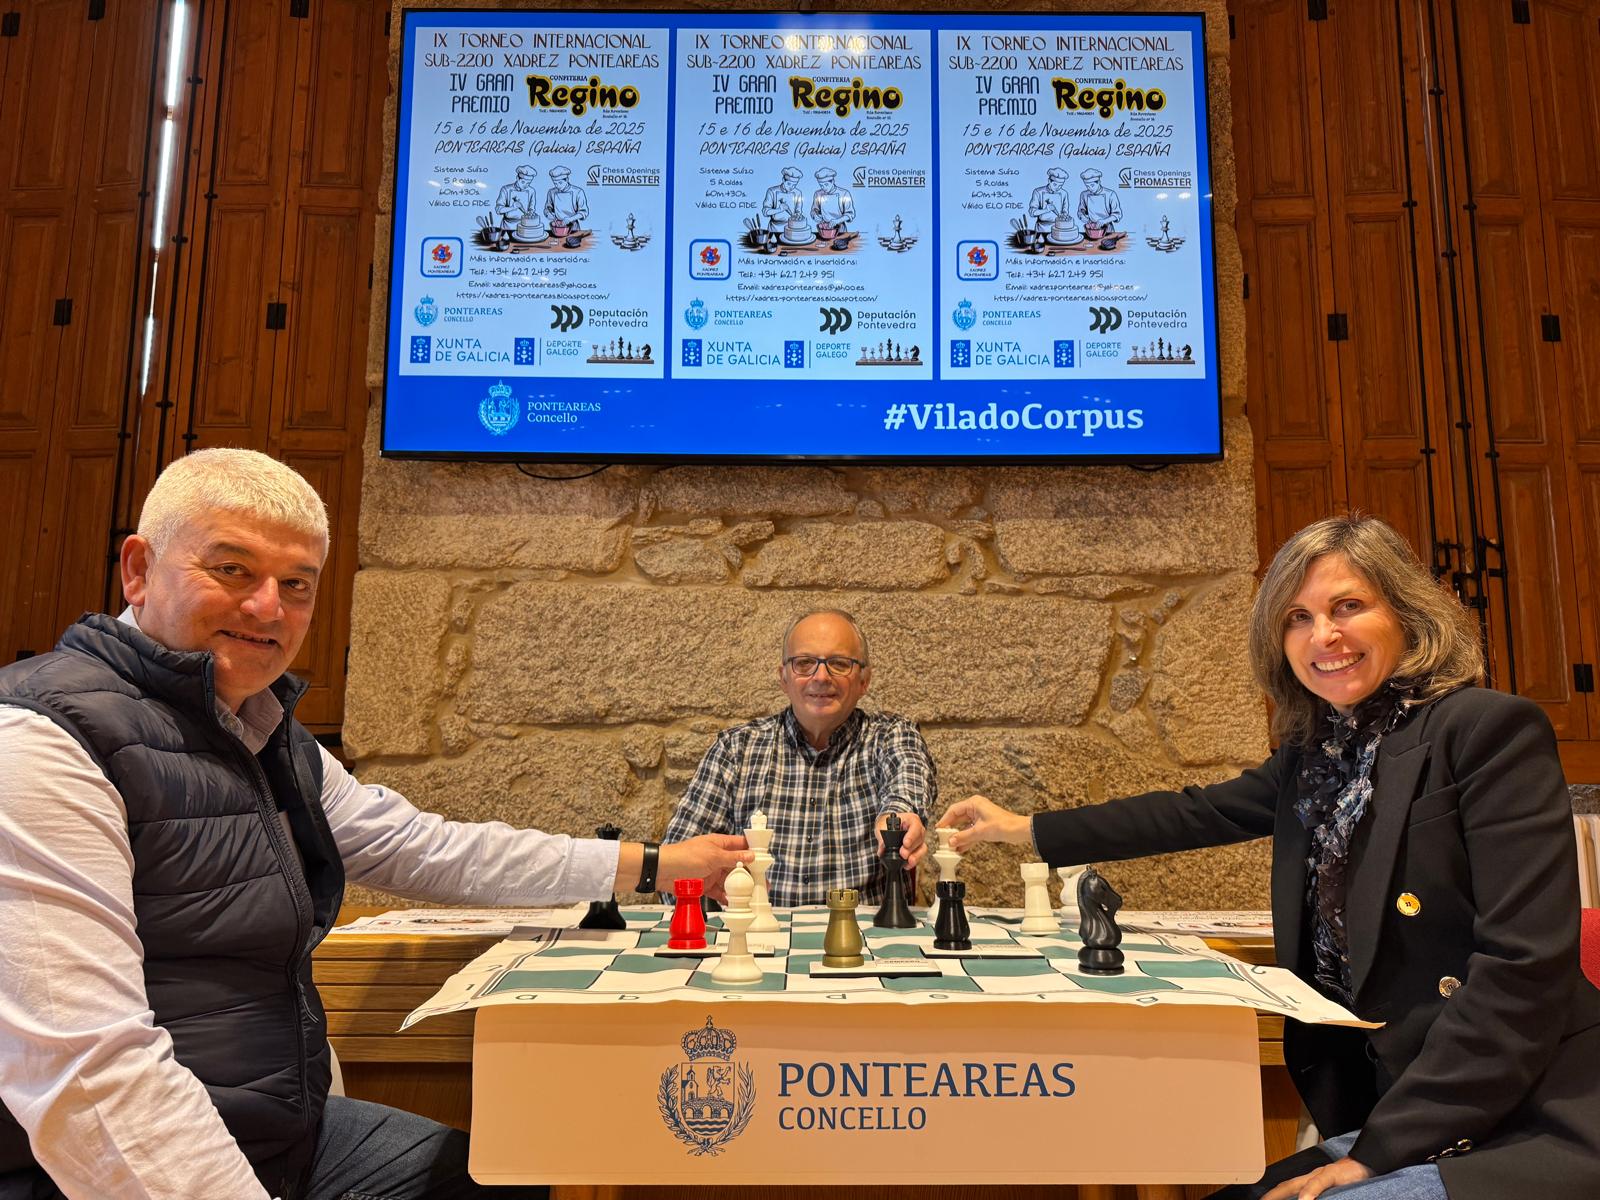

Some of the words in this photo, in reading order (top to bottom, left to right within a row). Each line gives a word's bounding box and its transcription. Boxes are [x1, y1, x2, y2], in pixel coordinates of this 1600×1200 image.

[433, 33, 448, 48] IX
[460, 34, 523, 48] TORNEO
[533, 34, 651, 49] INTERNACIONAL
[695, 34, 709, 49] IX
[721, 34, 785, 49] TORNEO
[957, 36, 971, 50] IX
[982, 36, 1046, 50] TORNEO
[1056, 37, 1174, 51] INTERNACIONAL
[425, 53, 493, 67] SUB-2200
[503, 54, 559, 68] XADREZ
[569, 55, 659, 68] PONTEAREAS
[687, 55, 755, 69] SUB-2200
[766, 55, 821, 69] XADREZ
[832, 56, 921, 69] PONTEAREAS
[949, 56, 1018, 70] SUB-2200
[1028, 56, 1083, 70] XADREZ
[1094, 57, 1184, 71] PONTEAREAS
[450, 74, 467, 91] IV
[477, 74, 514, 91] GRAN
[713, 75, 730, 92] IV
[739, 75, 776, 92] GRAN
[976, 76, 992, 94] IV
[1002, 76, 1039, 94] GRAN
[526, 75, 640, 116] Regino
[789, 76, 903, 118] Regino
[1052, 77, 1166, 119] Regino
[452, 95, 509, 113] PREMIO
[716, 97, 773, 114] PREMIO
[979, 98, 1036, 115] PREMIO
[434, 121, 453, 134] 15
[456, 125, 463, 134] e
[469, 122, 486, 134] 16
[491, 120, 508, 134] de
[509, 120, 581, 135] Novembro
[586, 121, 602, 134] de
[605, 122, 645, 135] 2025
[699, 123, 715, 136] 15
[720, 127, 727, 136] e
[734, 123, 750, 136] 16
[755, 121, 772, 136] de
[775, 121, 846, 136] Novembro
[850, 121, 867, 136] de
[870, 124, 909, 136] 2025
[963, 124, 980, 137] 15
[984, 129, 992, 137] e
[998, 124, 1015, 137] 16
[1020, 122, 1037, 137] de
[1039, 122, 1110, 138] Novembro
[1114, 123, 1131, 137] de
[1134, 125, 1173, 138] 2025
[435, 141, 525, 154] PONTEAREAS
[529, 140, 582, 156] (Galicia)
[586, 139, 641, 154] ESPAÑA
[700, 142, 789, 155] PONTEAREAS
[793, 142, 846, 158] (Galicia)
[851, 141, 906, 155] ESPAÑA
[965, 143, 1054, 156] PONTEAREAS
[1058, 143, 1111, 159] (Galicia)
[1116, 142, 1171, 157] ESPAÑA
[626, 167, 660, 176] Openings
[891, 169, 925, 177] Openings
[1158, 170, 1191, 178] Openings
[602, 175, 659, 184] PROMASTER
[868, 177, 925, 185] PROMASTER
[1134, 178, 1191, 186] PROMASTER
[490, 268, 508, 276] +34
[512, 268, 529, 276] 627
[531, 268, 550, 276] 249
[553, 268, 567, 276] 951
[780, 270, 797, 278] 627
[799, 270, 818, 278] 249
[445, 307, 502, 316] PONTEAREAS
[589, 309, 648, 318] Deputación
[715, 310, 772, 318] PONTEAREAS
[858, 310, 916, 320] Deputación
[983, 310, 1040, 318] PONTEAREAS
[1128, 310, 1187, 319] Deputación
[589, 318, 648, 328] Pontevedra
[858, 321, 916, 330] Pontevedra
[1128, 320, 1187, 329] Pontevedra
[436, 339, 482, 349] XUNTA
[707, 342, 752, 351] XUNTA
[976, 342, 1021, 352] XUNTA
[436, 351, 452, 361] DE
[455, 351, 510, 362] GALICIA
[707, 354, 723, 364] DE
[728, 354, 780, 365] GALICIA
[1086, 350, 1118, 358] GALEGO
[975, 355, 991, 365] DE
[997, 355, 1050, 366] GALICIA
[528, 402, 601, 412] PONTEAREAS
[527, 412, 578, 423] Concello
[884, 403, 1143, 437] #ViladoCorpus
[778, 1062, 1076, 1098] PONTEAREAS
[779, 1107, 926, 1130] CONCELLO
